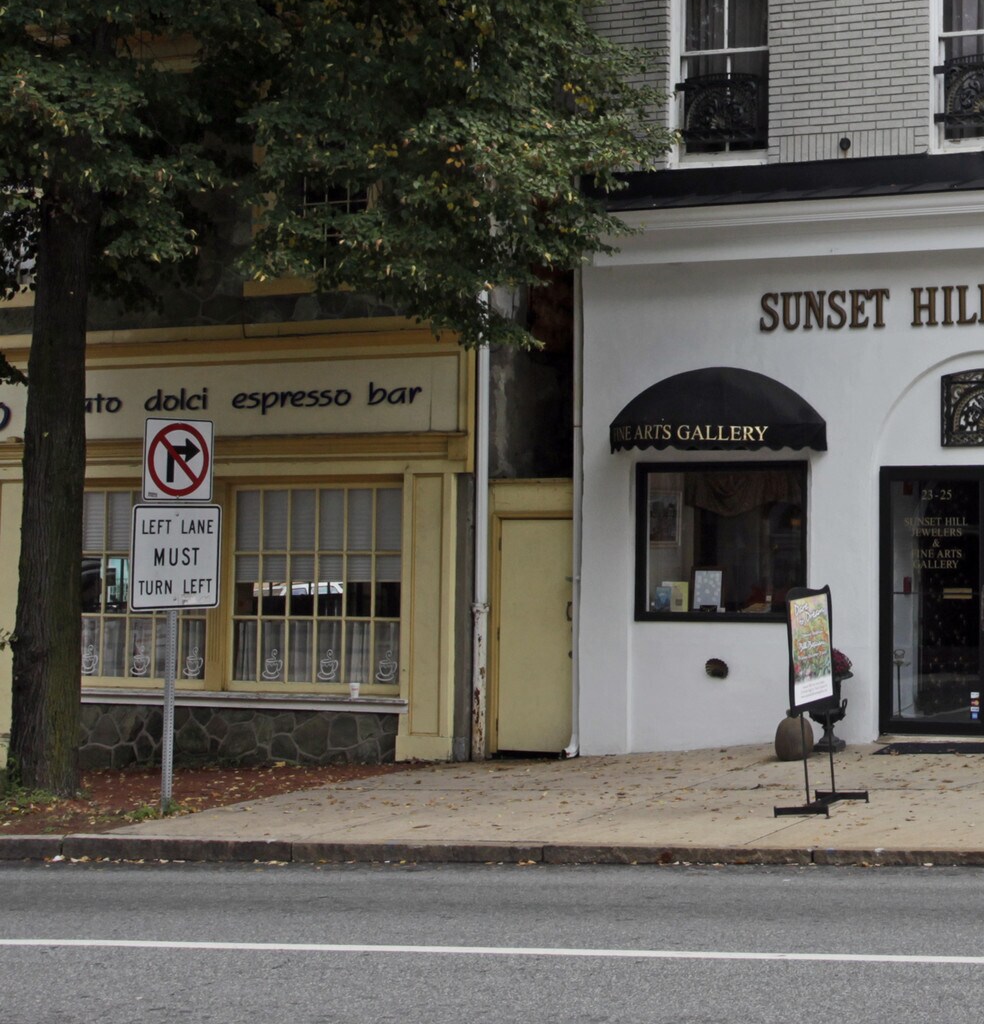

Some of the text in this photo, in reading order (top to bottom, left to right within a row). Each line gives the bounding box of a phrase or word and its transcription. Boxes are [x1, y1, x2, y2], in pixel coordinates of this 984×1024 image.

[759, 288, 890, 332] SUNSET
[144, 387, 208, 411] dolci
[231, 389, 351, 415] espresso
[367, 381, 422, 405] bar
[633, 424, 671, 440] ARTS
[677, 424, 768, 441] GALLERY
[921, 489, 952, 500] 23-25
[142, 519, 214, 534] LEFT LANE
[904, 517, 968, 526] SUNSET HILL
[912, 527, 962, 537] JEWELERS
[932, 538, 940, 547] &
[153, 547, 200, 566] MUST
[938, 549, 962, 558] ARTS
[912, 560, 958, 569] GALLERY
[138, 578, 212, 595] TURN LEFT
